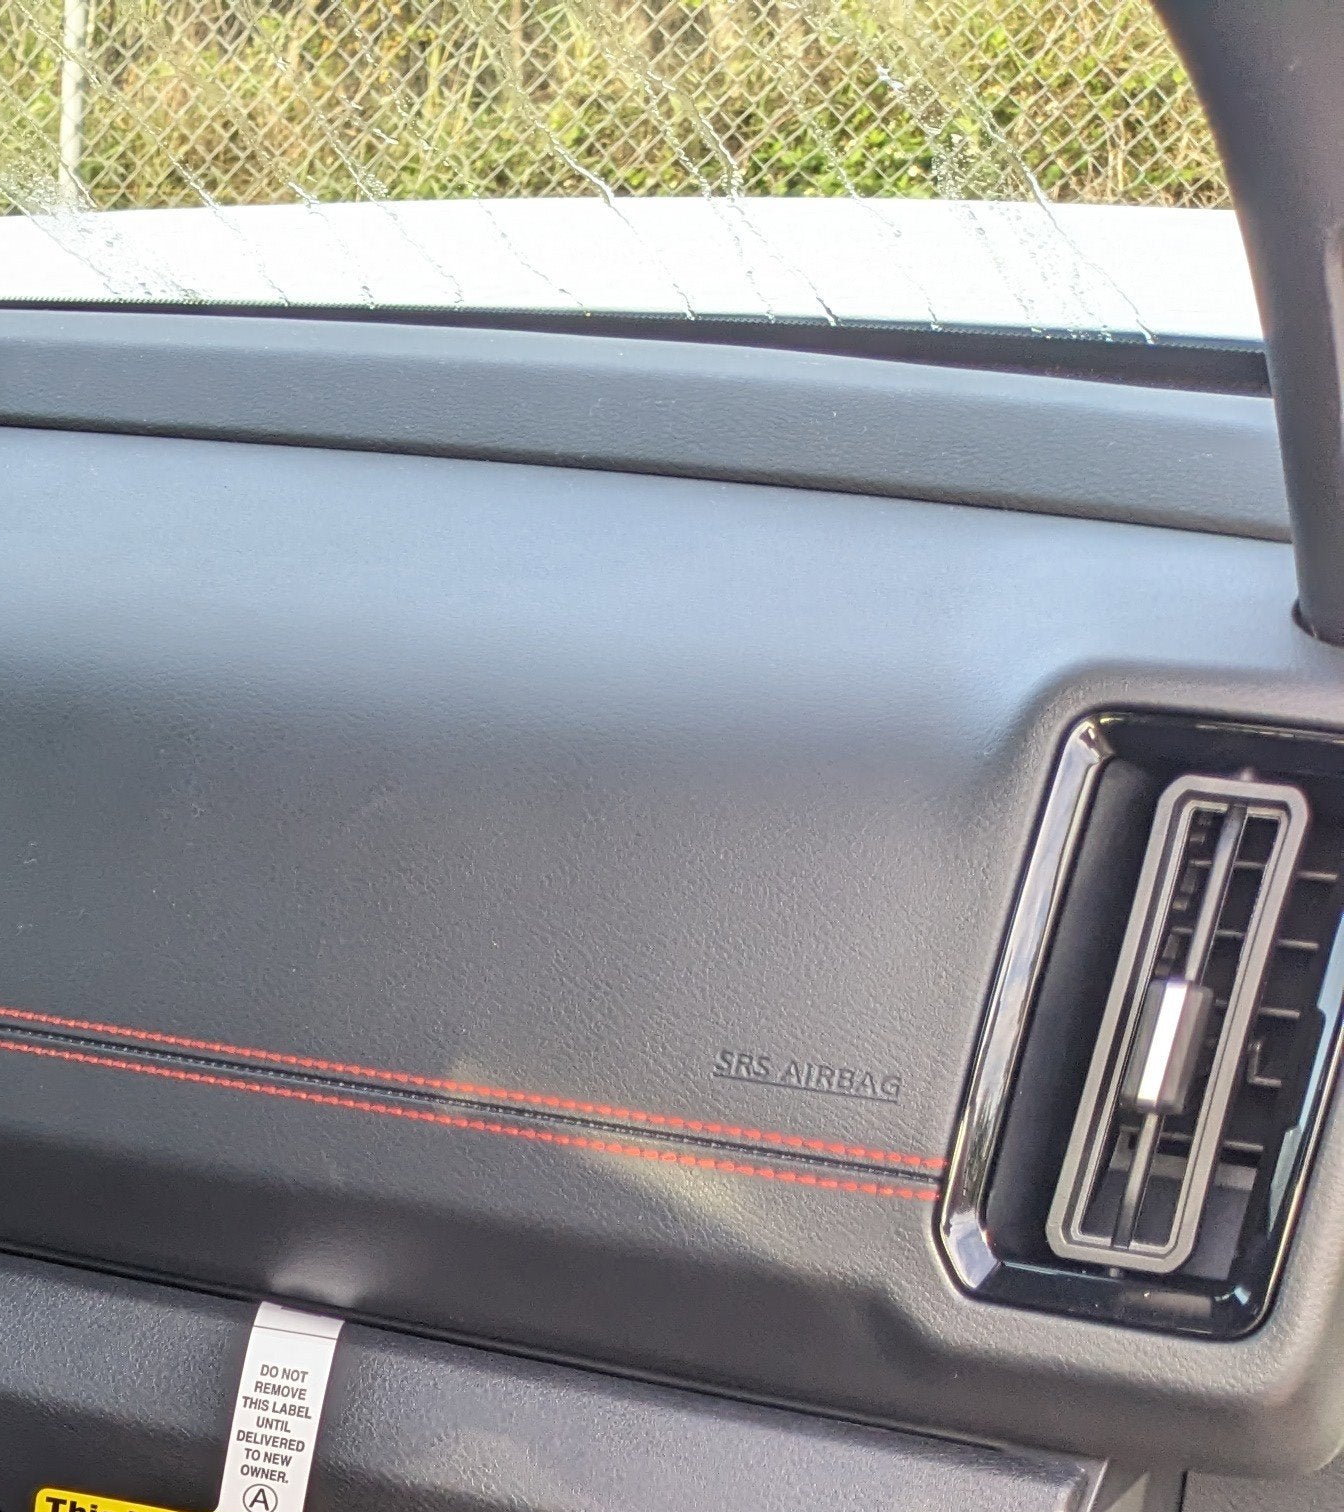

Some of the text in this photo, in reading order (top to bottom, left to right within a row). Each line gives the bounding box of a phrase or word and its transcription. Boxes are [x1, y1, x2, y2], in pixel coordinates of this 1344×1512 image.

[713, 1050, 904, 1098] SRS AIRBAG
[260, 1364, 308, 1383] DO NOT
[254, 1381, 307, 1400] REMOVE
[242, 1396, 312, 1419] THIS LABEL
[256, 1416, 291, 1433] UNTIL
[236, 1429, 305, 1452] DELIVERED
[244, 1448, 292, 1467] TO NEW
[240, 1464, 289, 1484] OWNER.
